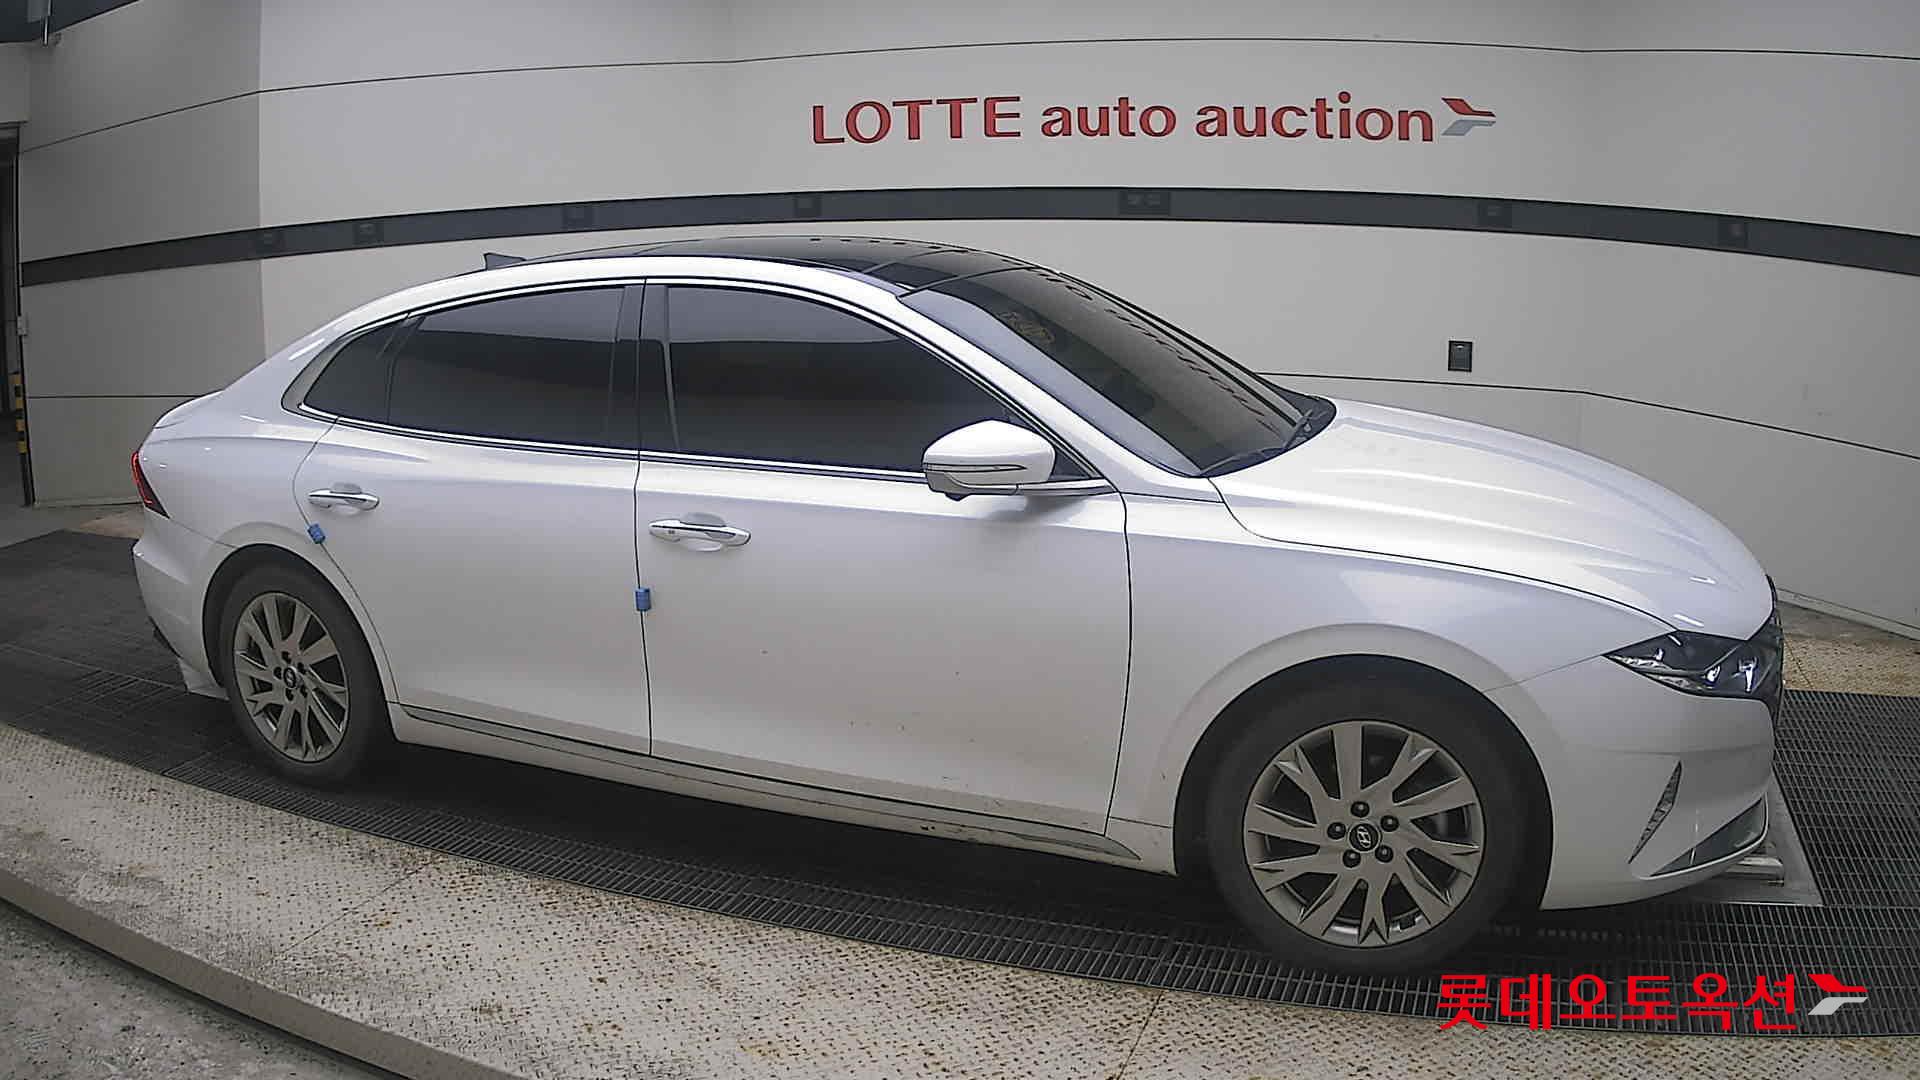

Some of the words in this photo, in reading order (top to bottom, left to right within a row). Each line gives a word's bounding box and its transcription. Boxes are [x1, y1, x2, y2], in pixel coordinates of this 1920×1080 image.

[812, 96, 1021, 143] LOTTE
[1041, 97, 1177, 138] auto
[1196, 92, 1433, 142] auction
